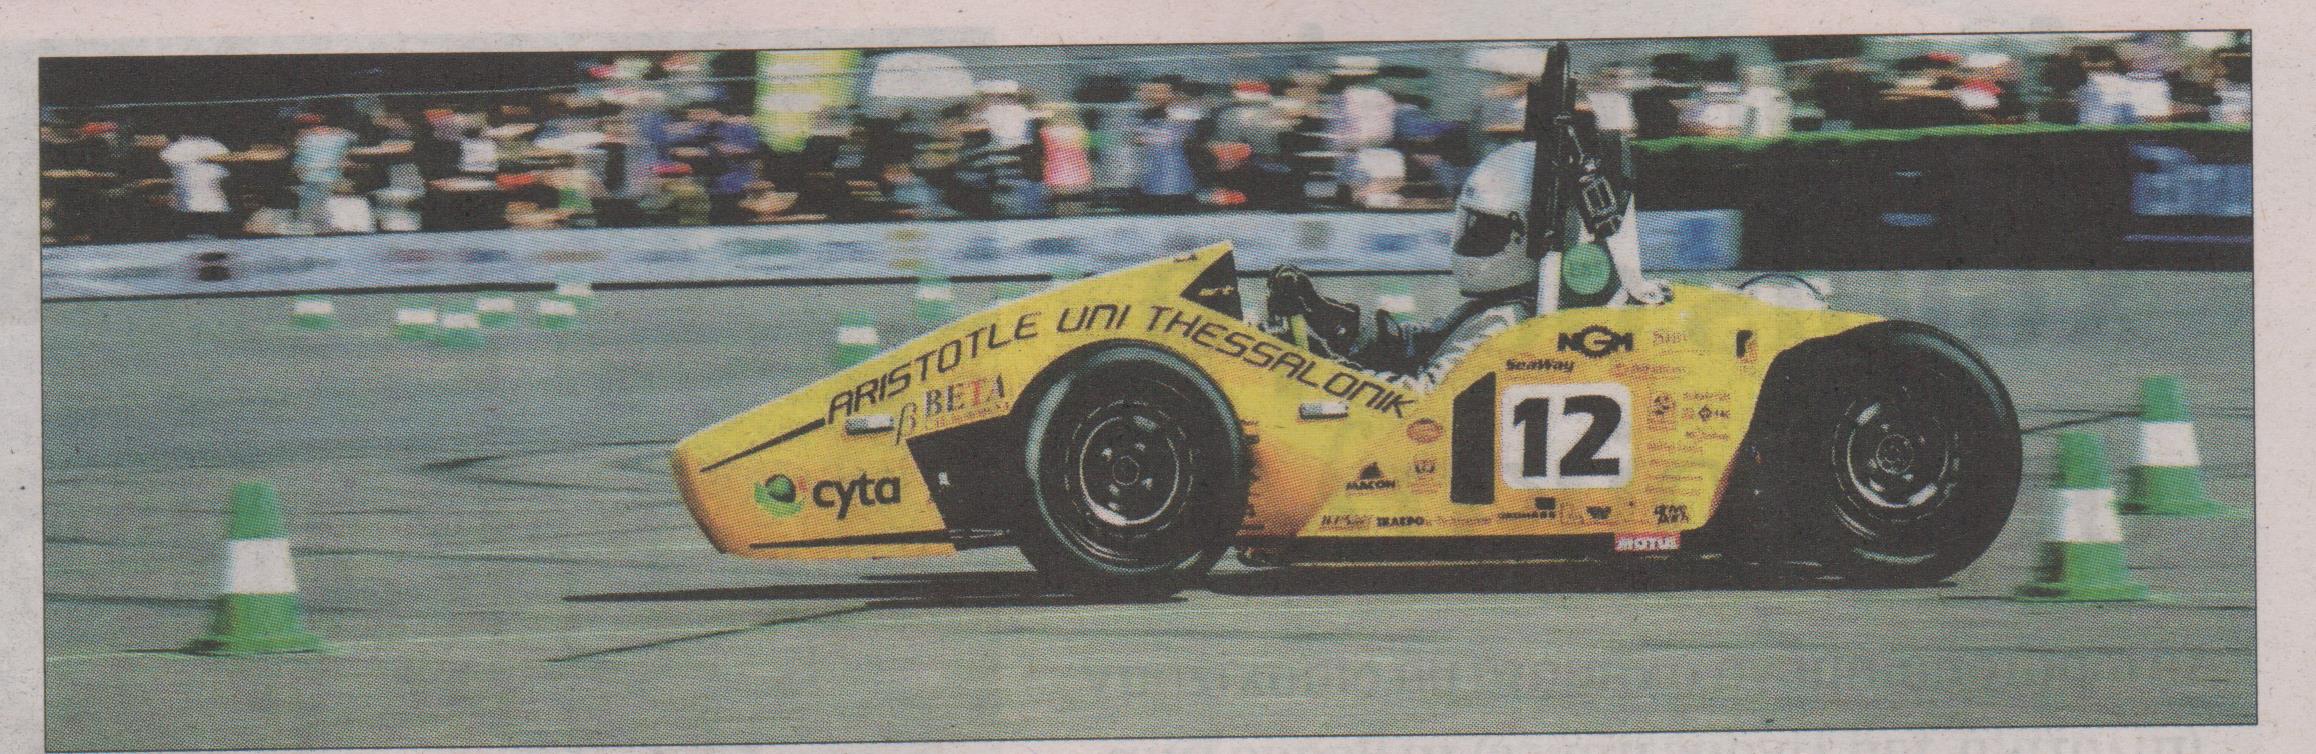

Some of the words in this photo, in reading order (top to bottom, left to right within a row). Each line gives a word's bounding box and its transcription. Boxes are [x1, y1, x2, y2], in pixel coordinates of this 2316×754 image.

[827, 311, 1042, 425] ARISTOTLE
[1145, 305, 1418, 419] THESSALONIK
[925, 373, 1005, 418] BETA
[1513, 394, 1621, 477] 12
[812, 472, 900, 519] cyta
